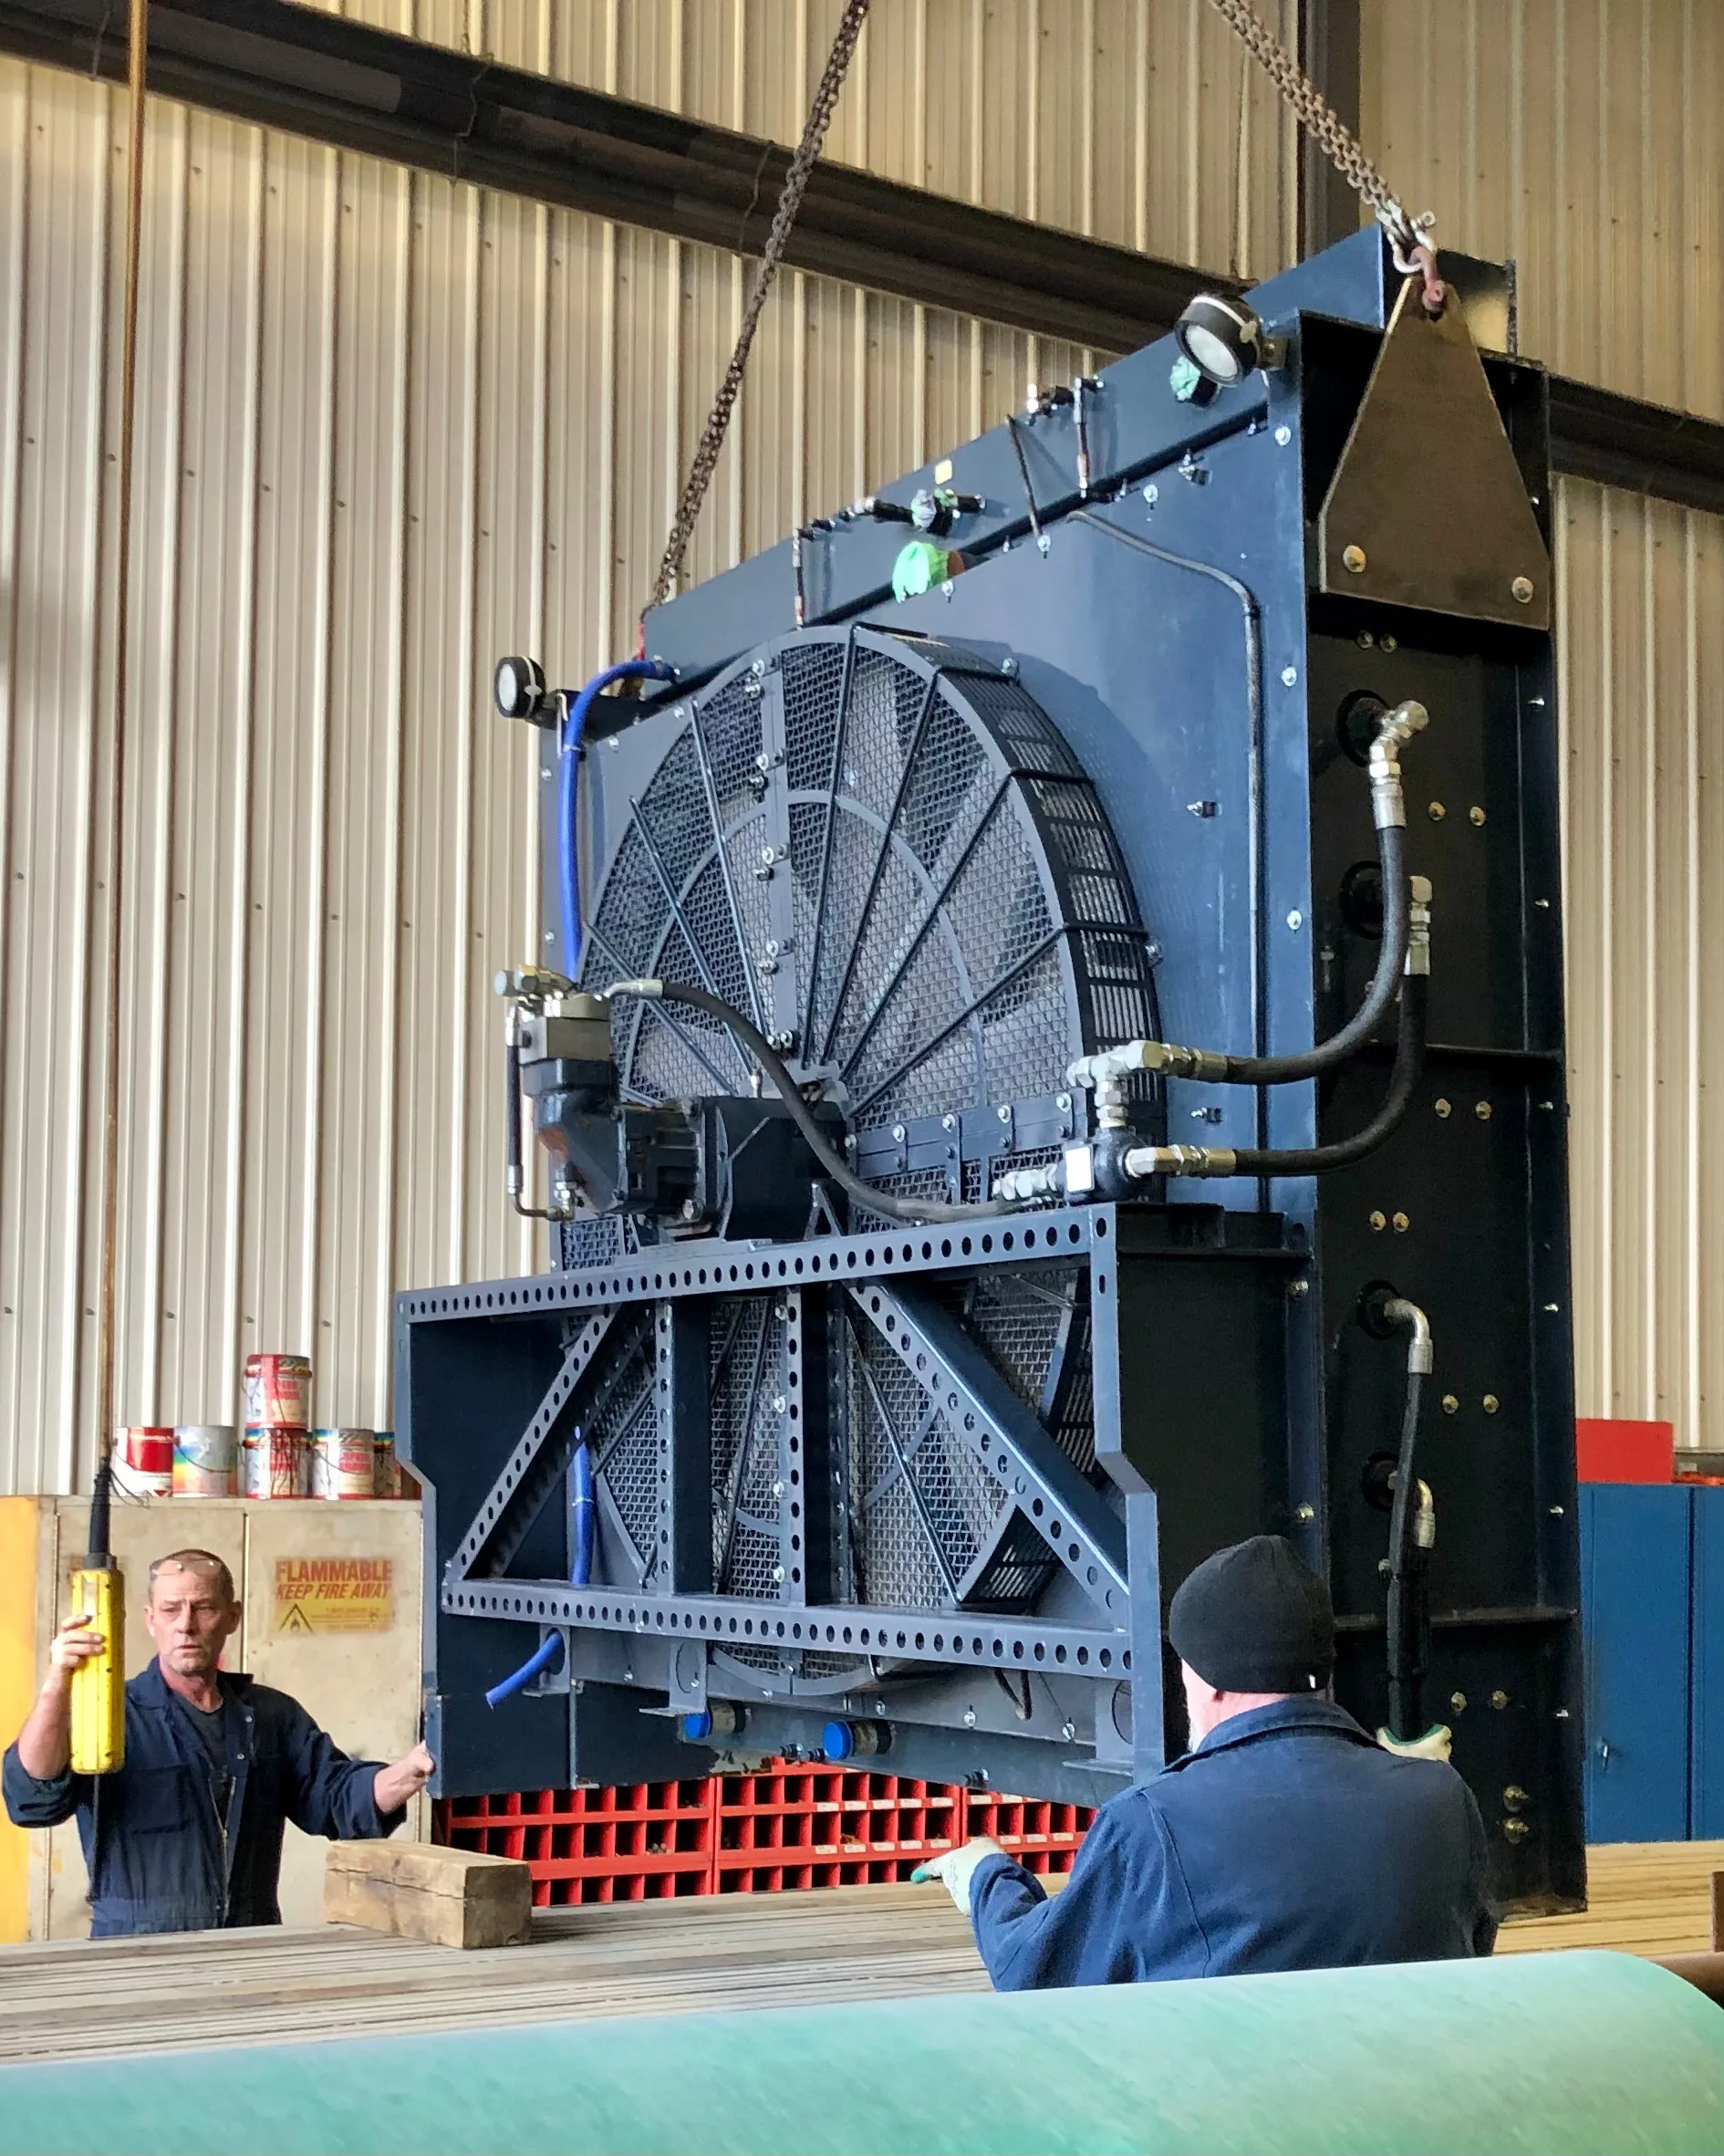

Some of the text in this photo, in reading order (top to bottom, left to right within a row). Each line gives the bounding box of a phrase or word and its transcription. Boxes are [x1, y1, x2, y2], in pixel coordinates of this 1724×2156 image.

[275, 1560, 391, 1581] FLAMMABLE
[276, 1584, 390, 1599] KEEP FIRE AWAY
